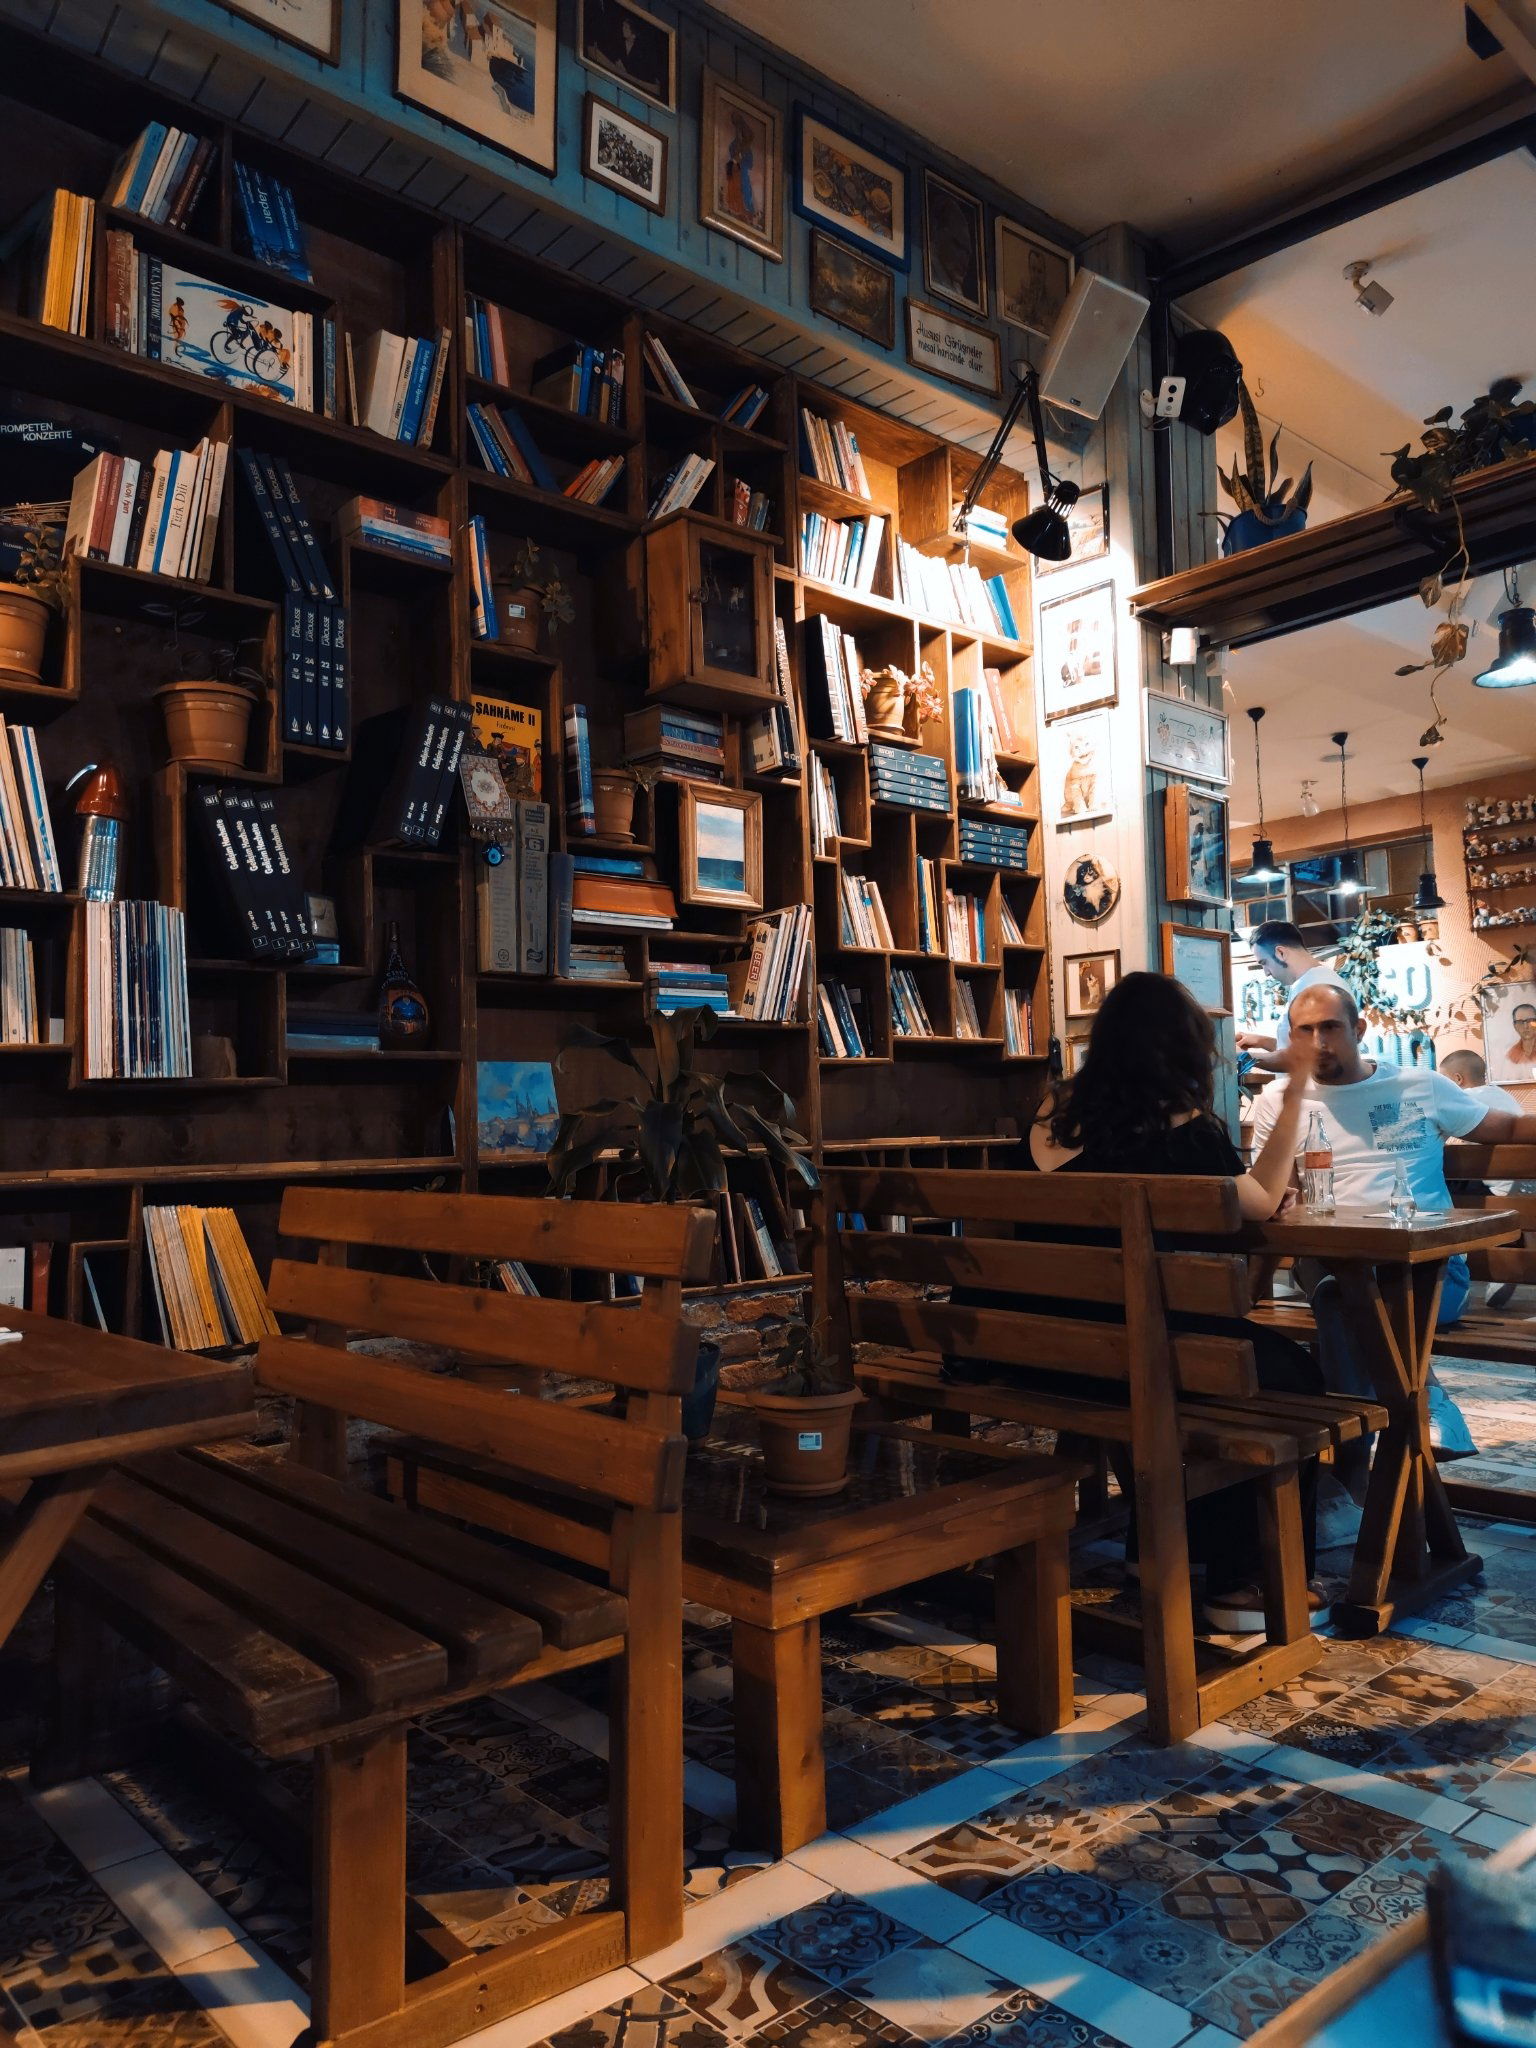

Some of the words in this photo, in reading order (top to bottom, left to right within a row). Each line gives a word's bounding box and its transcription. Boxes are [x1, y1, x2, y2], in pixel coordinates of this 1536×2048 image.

[258, 189, 273, 224] Japan
[918, 340, 936, 355] mesai
[0, 422, 53, 433] ROMPETEN
[23, 430, 73, 441] KONZERTE
[174, 483, 188, 503] Dili
[170, 507, 184, 529] Türk
[292, 652, 301, 660] 17
[321, 660, 331, 669] 22
[475, 702, 525, 723] ŞAHNÂME
[528, 714, 535, 726] II
[424, 723, 435, 747] Hachette
[437, 727, 449, 750] Hachette
[453, 730, 465, 753] Hachette
[419, 746, 430, 767] Gelişim
[432, 749, 443, 770] Gelişim
[448, 752, 459, 773] Gelişim
[216, 818, 231, 847] Hachette
[236, 820, 250, 849] Hachette
[251, 822, 265, 851] Hachette
[270, 823, 284, 851] Hachette
[225, 846, 239, 870] Gelişim
[245, 848, 258, 872] Gelişim
[260, 850, 273, 875] Gelişim
[278, 850, 290, 875] Gelişim
[751, 952, 762, 980] BEER
